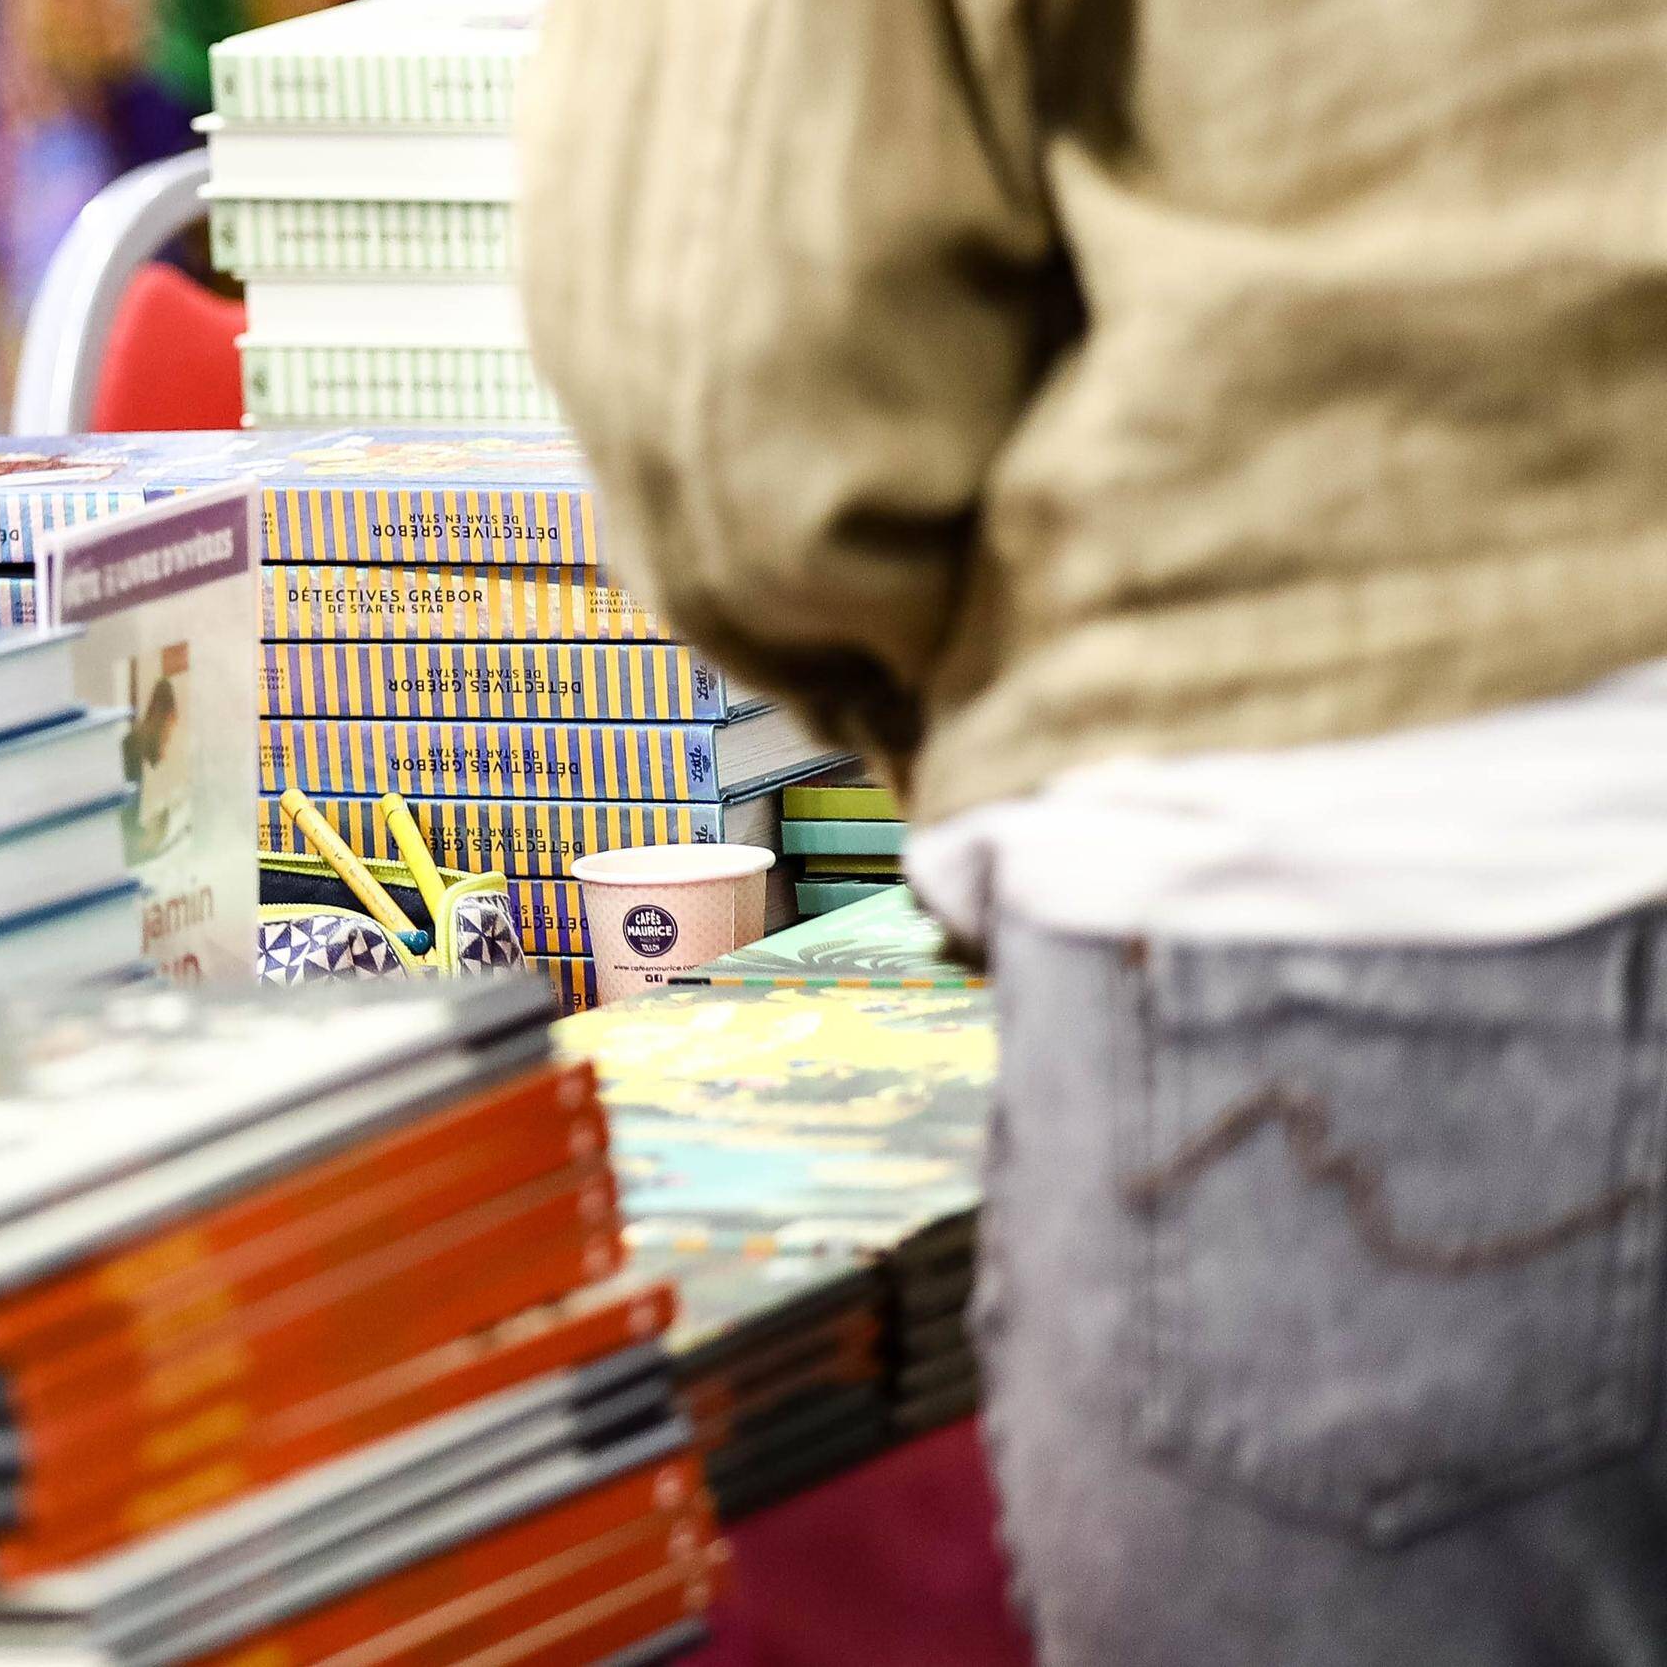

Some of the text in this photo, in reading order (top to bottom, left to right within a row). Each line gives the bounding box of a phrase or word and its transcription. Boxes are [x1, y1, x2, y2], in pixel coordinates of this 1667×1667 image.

[409, 512, 519, 525] DE STAR EN STAR
[372, 523, 558, 543] DÉTECTIVES GRÉBOR
[288, 586, 483, 603] DÉTECTIVES GRÉBOR
[328, 605, 444, 614] DE STAR EN STAR
[426, 668, 541, 680] DE STAR EN STAR
[388, 679, 582, 698] DÉTECTIVES GRÉBOR
[427, 747, 539, 760] DE STAR EN STAR
[391, 758, 579, 779] DÉTECTIVES GRÉBOR
[429, 826, 543, 838] DE STAR EN STAR
[473, 839, 583, 857] DÉTECTIVES
[533, 905, 549, 915] DE
[635, 910, 661, 925] CAFÉS
[627, 925, 673, 937] MAURICE
